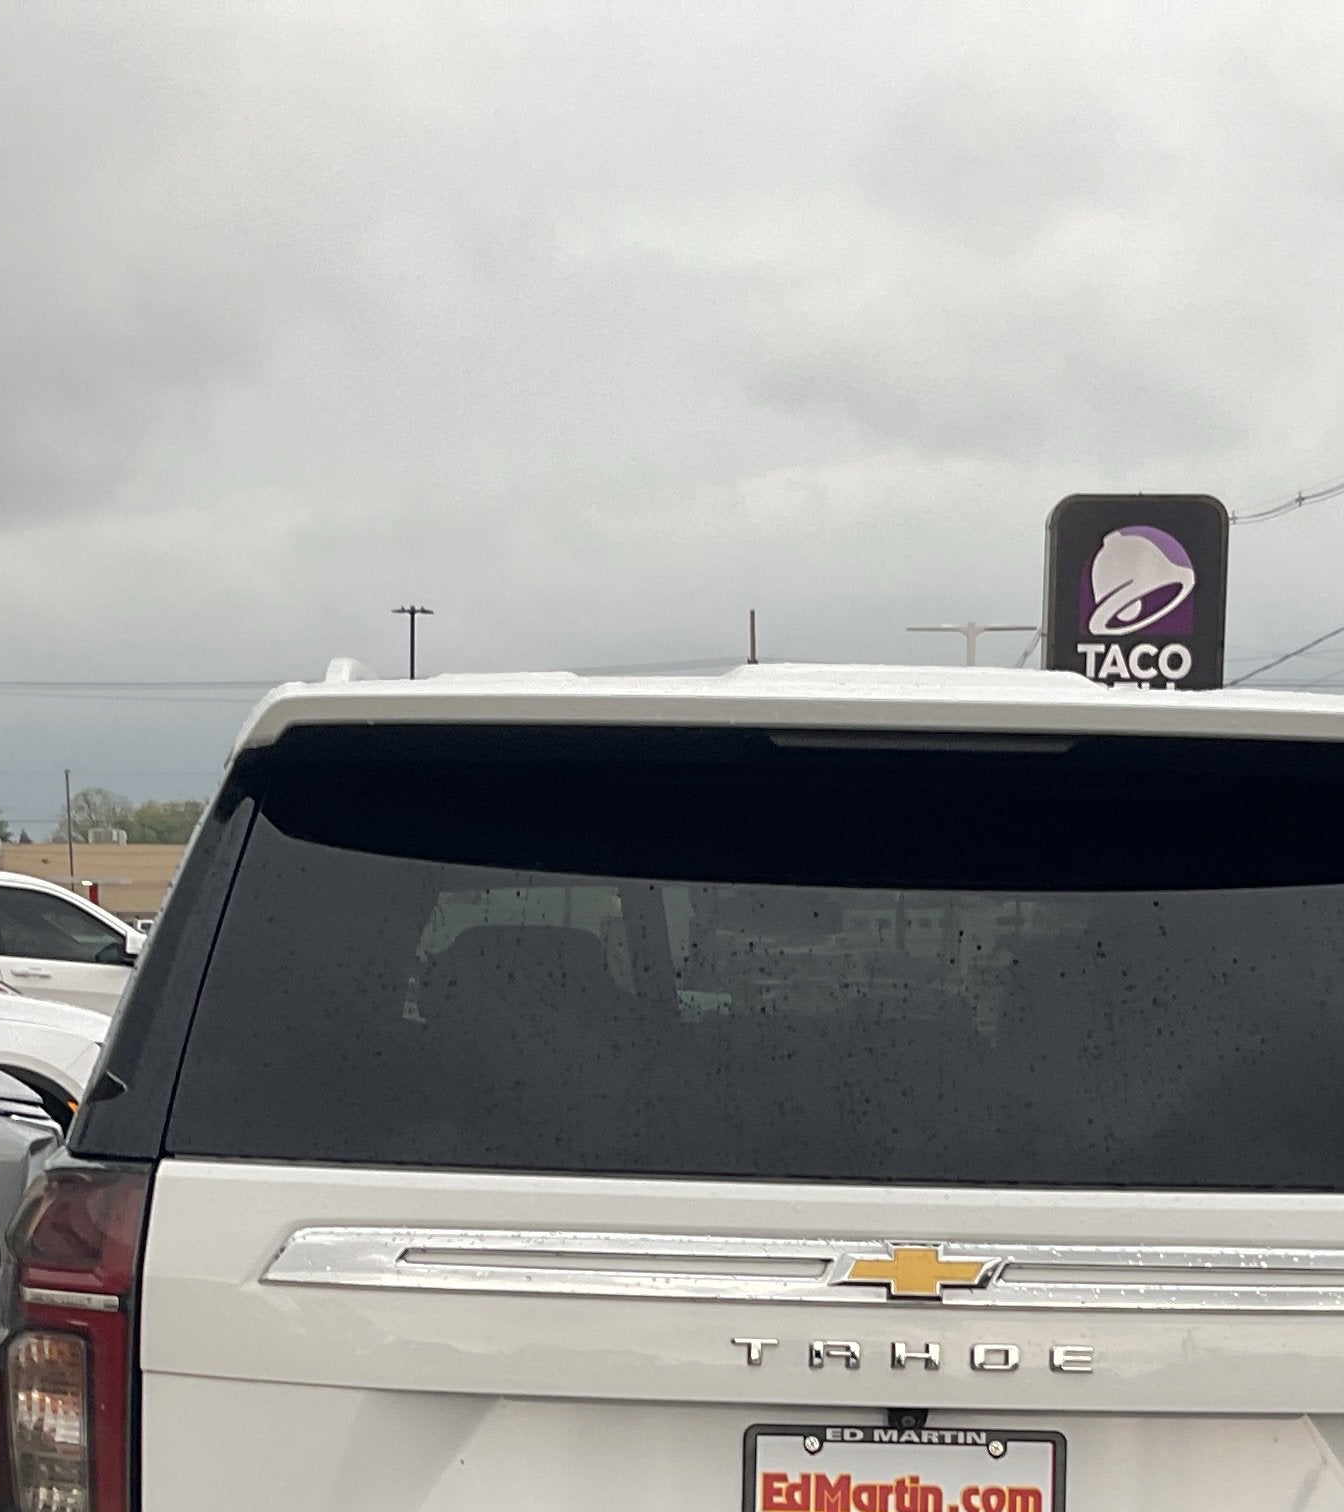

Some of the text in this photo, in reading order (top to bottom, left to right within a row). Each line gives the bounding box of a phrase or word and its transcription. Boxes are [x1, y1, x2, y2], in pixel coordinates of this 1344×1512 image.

[1076, 643, 1192, 680] TACO
[730, 1337, 1095, 1374] TAHOE
[825, 1427, 988, 1446] ED MARTIN
